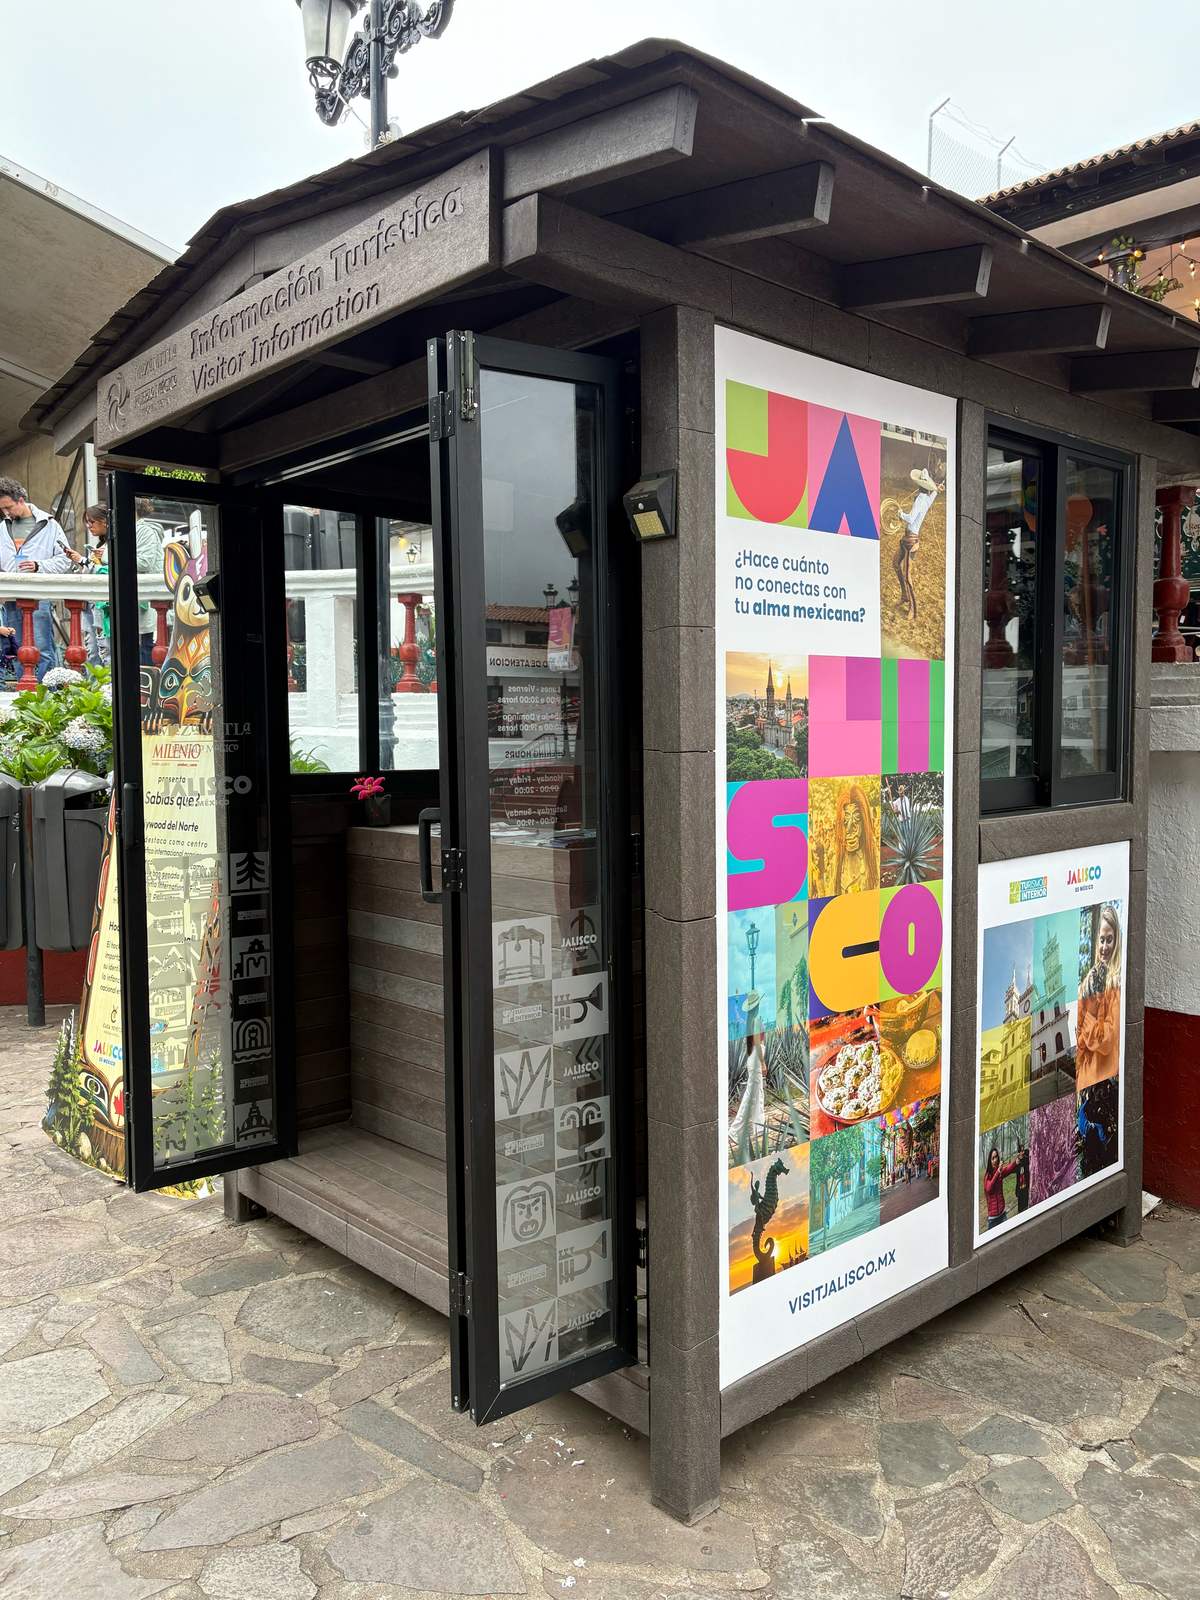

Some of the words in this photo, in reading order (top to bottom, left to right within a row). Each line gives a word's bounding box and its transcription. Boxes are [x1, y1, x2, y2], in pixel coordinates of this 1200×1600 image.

[190, 264, 325, 359] Información
[330, 187, 465, 282] Turística
[192, 350, 247, 394] Visitor
[250, 283, 379, 366] Information
[735, 549, 779, 569] ¿Hace
[782, 555, 830, 575] cuánto
[735, 575, 753, 590] no
[757, 578, 820, 597] conectas
[823, 584, 847, 600] con
[734, 597, 750, 614] tu
[752, 598, 790, 618] alma
[793, 602, 866, 623] mexicana?
[152, 743, 201, 760] MILENIO
[161, 775, 253, 797] JALISCO
[144, 819, 166, 832] ywood
[167, 820, 179, 831] del
[179, 821, 199, 833] Norte
[168, 838, 185, 847] como
[1067, 865, 1102, 885] JALISCO
[561, 934, 598, 948] JALISCO
[563, 1060, 599, 1077] JALISCO
[565, 1185, 601, 1204] JALISCO
[788, 1248, 897, 1315] VISITJALISCO.MX
[568, 1309, 602, 1329] JALISCO
